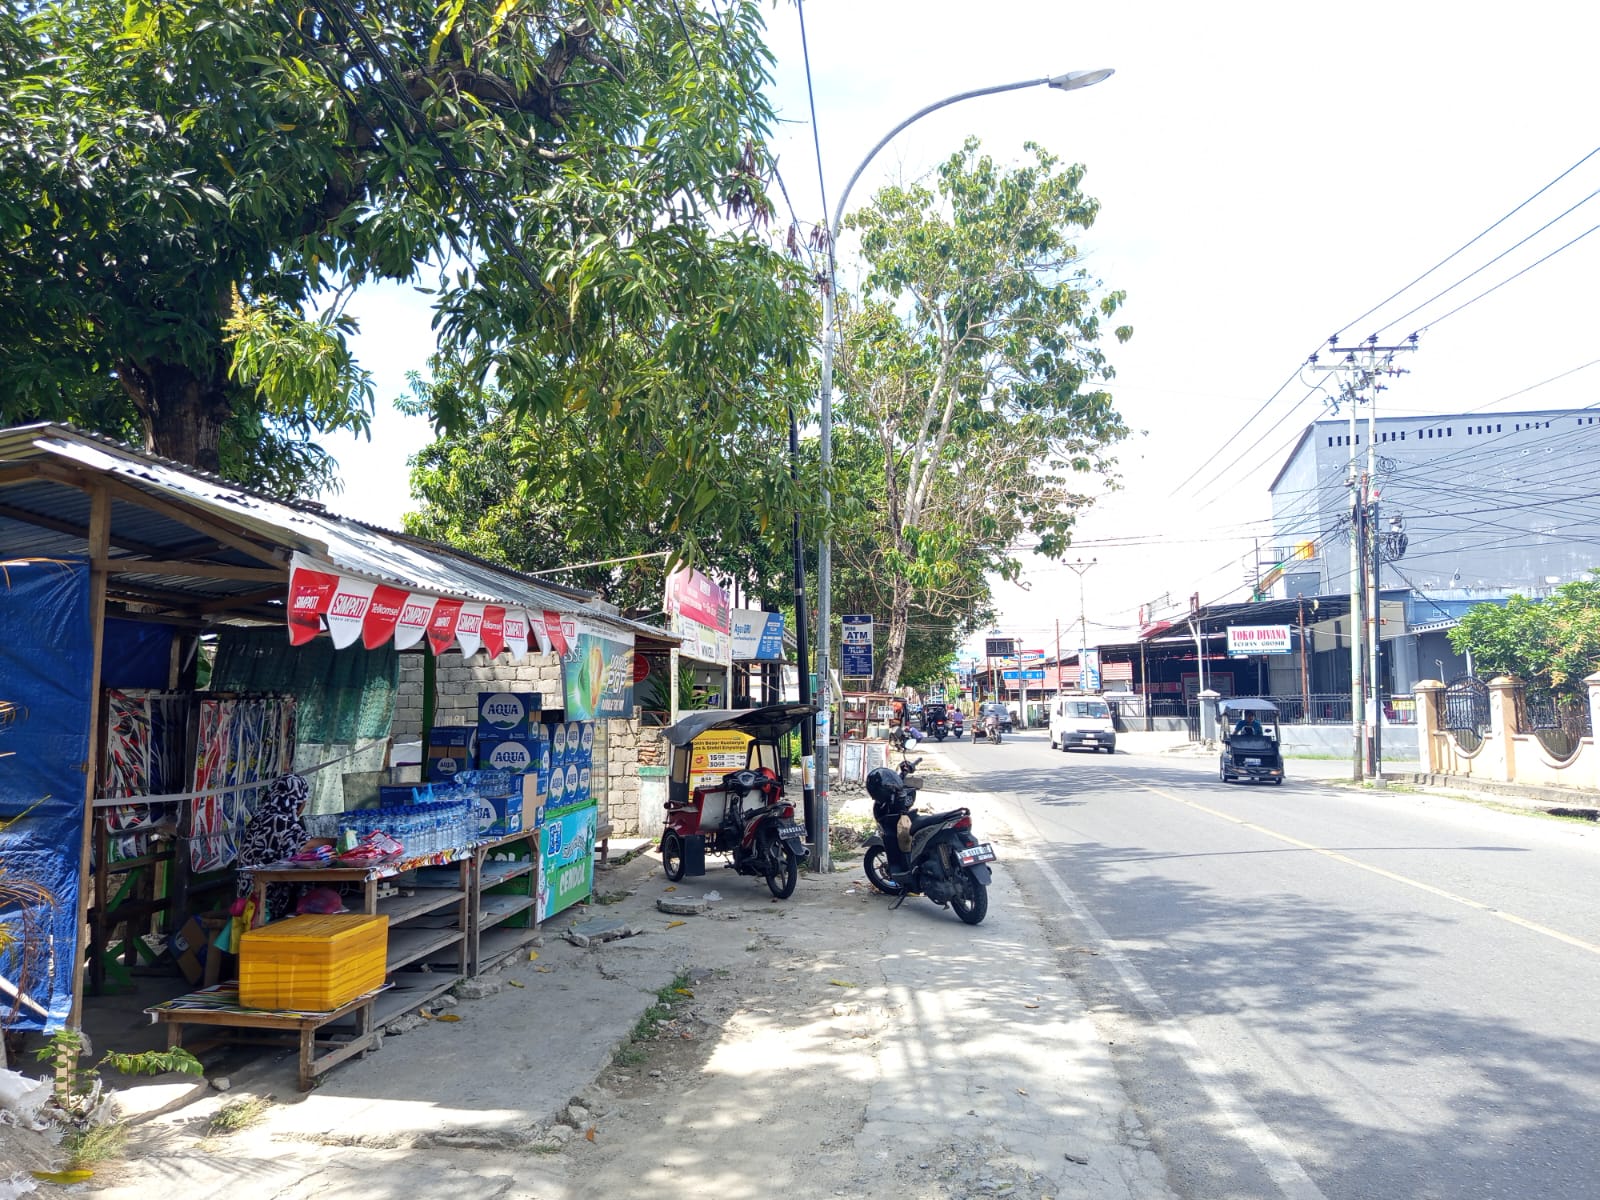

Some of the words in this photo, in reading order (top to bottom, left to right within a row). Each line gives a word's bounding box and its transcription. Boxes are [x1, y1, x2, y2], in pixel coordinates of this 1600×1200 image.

[294, 596, 319, 609] SIMPATI
[333, 595, 368, 617] SIMPATI
[371, 602, 401, 616] Telkomsel
[401, 604, 431, 625] SIMPATI
[847, 631, 868, 639] ATM
[1232, 630, 1254, 641] TOKO
[1257, 629, 1287, 640] DIVANA
[605, 670, 626, 694] POP
[488, 703, 519, 716] AQUA
[495, 751, 526, 763] AQUA
[560, 862, 585, 896] CENDOL
